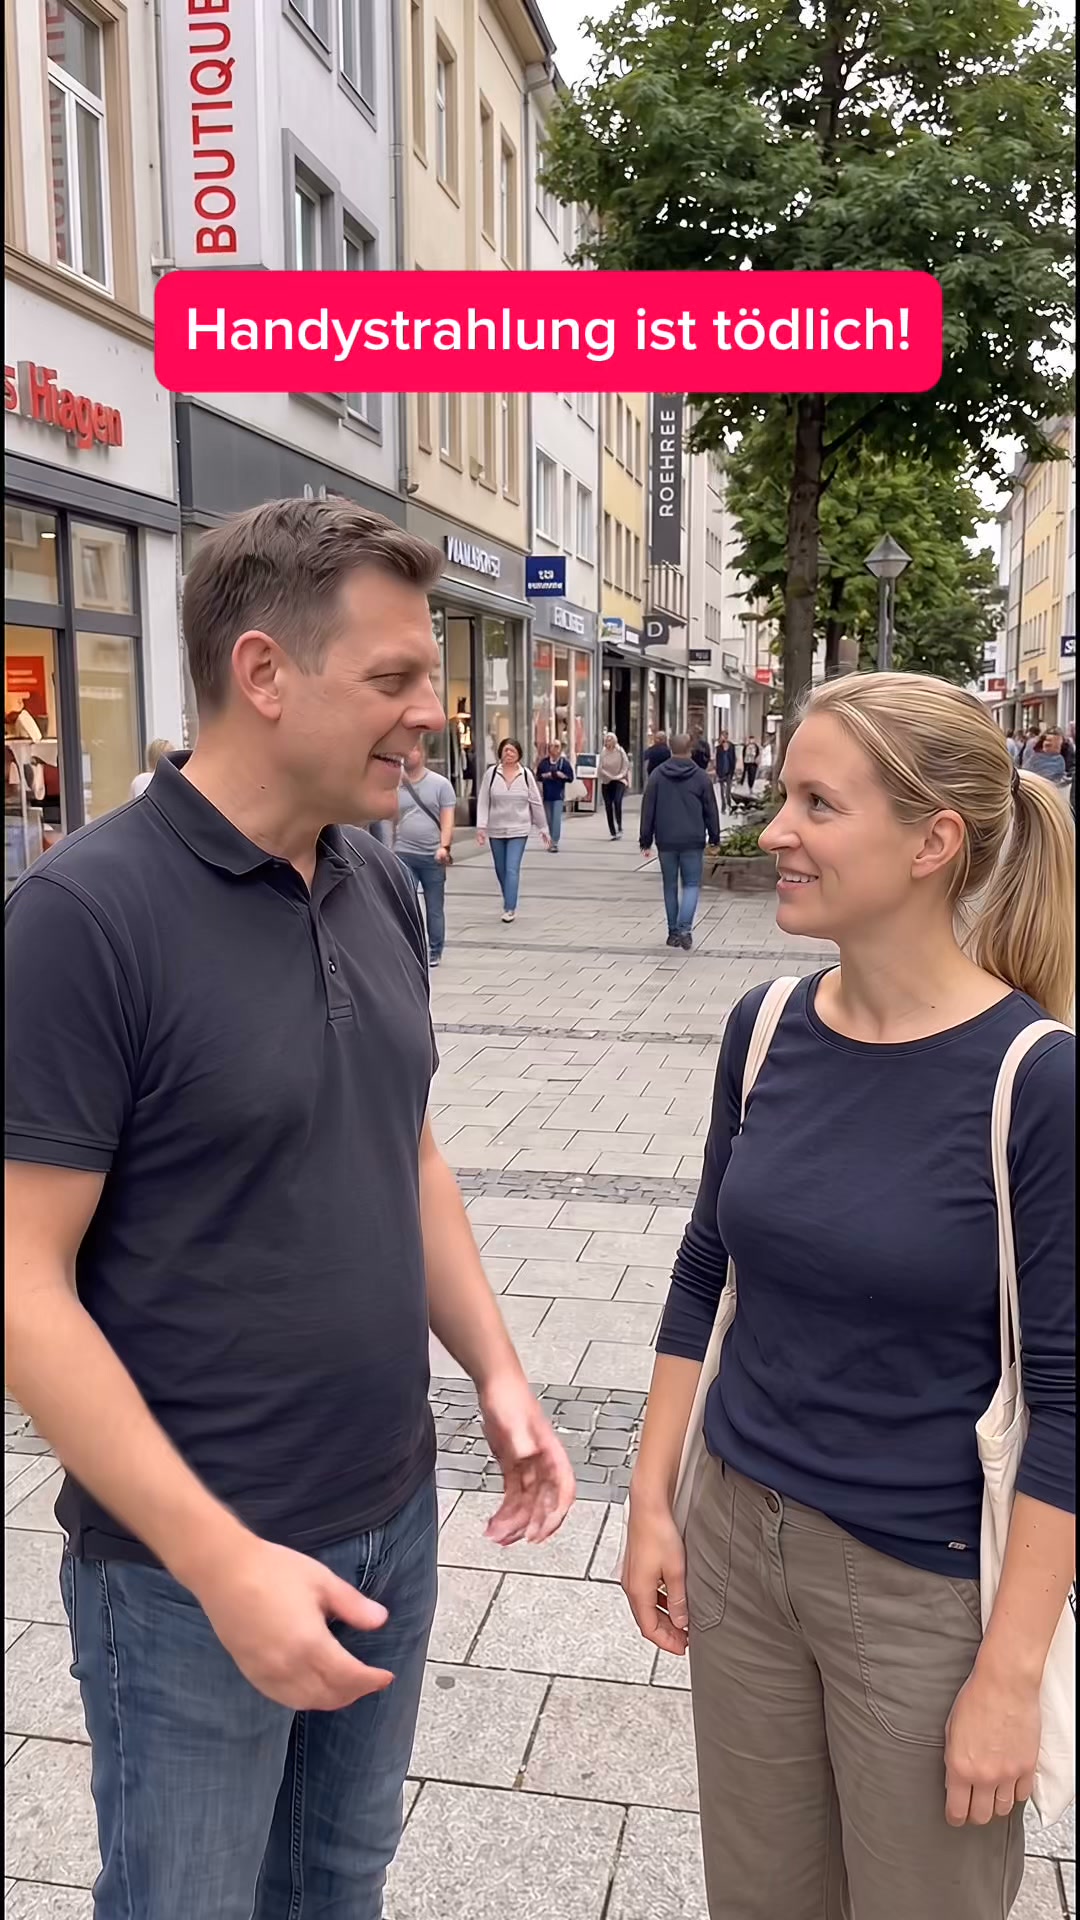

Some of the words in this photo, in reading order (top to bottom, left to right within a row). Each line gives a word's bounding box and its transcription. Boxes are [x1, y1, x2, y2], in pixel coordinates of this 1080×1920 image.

[188, 0, 236, 254] BOUTIQUE
[659, 410, 676, 517] ROEHREE
[647, 621, 663, 638] D
